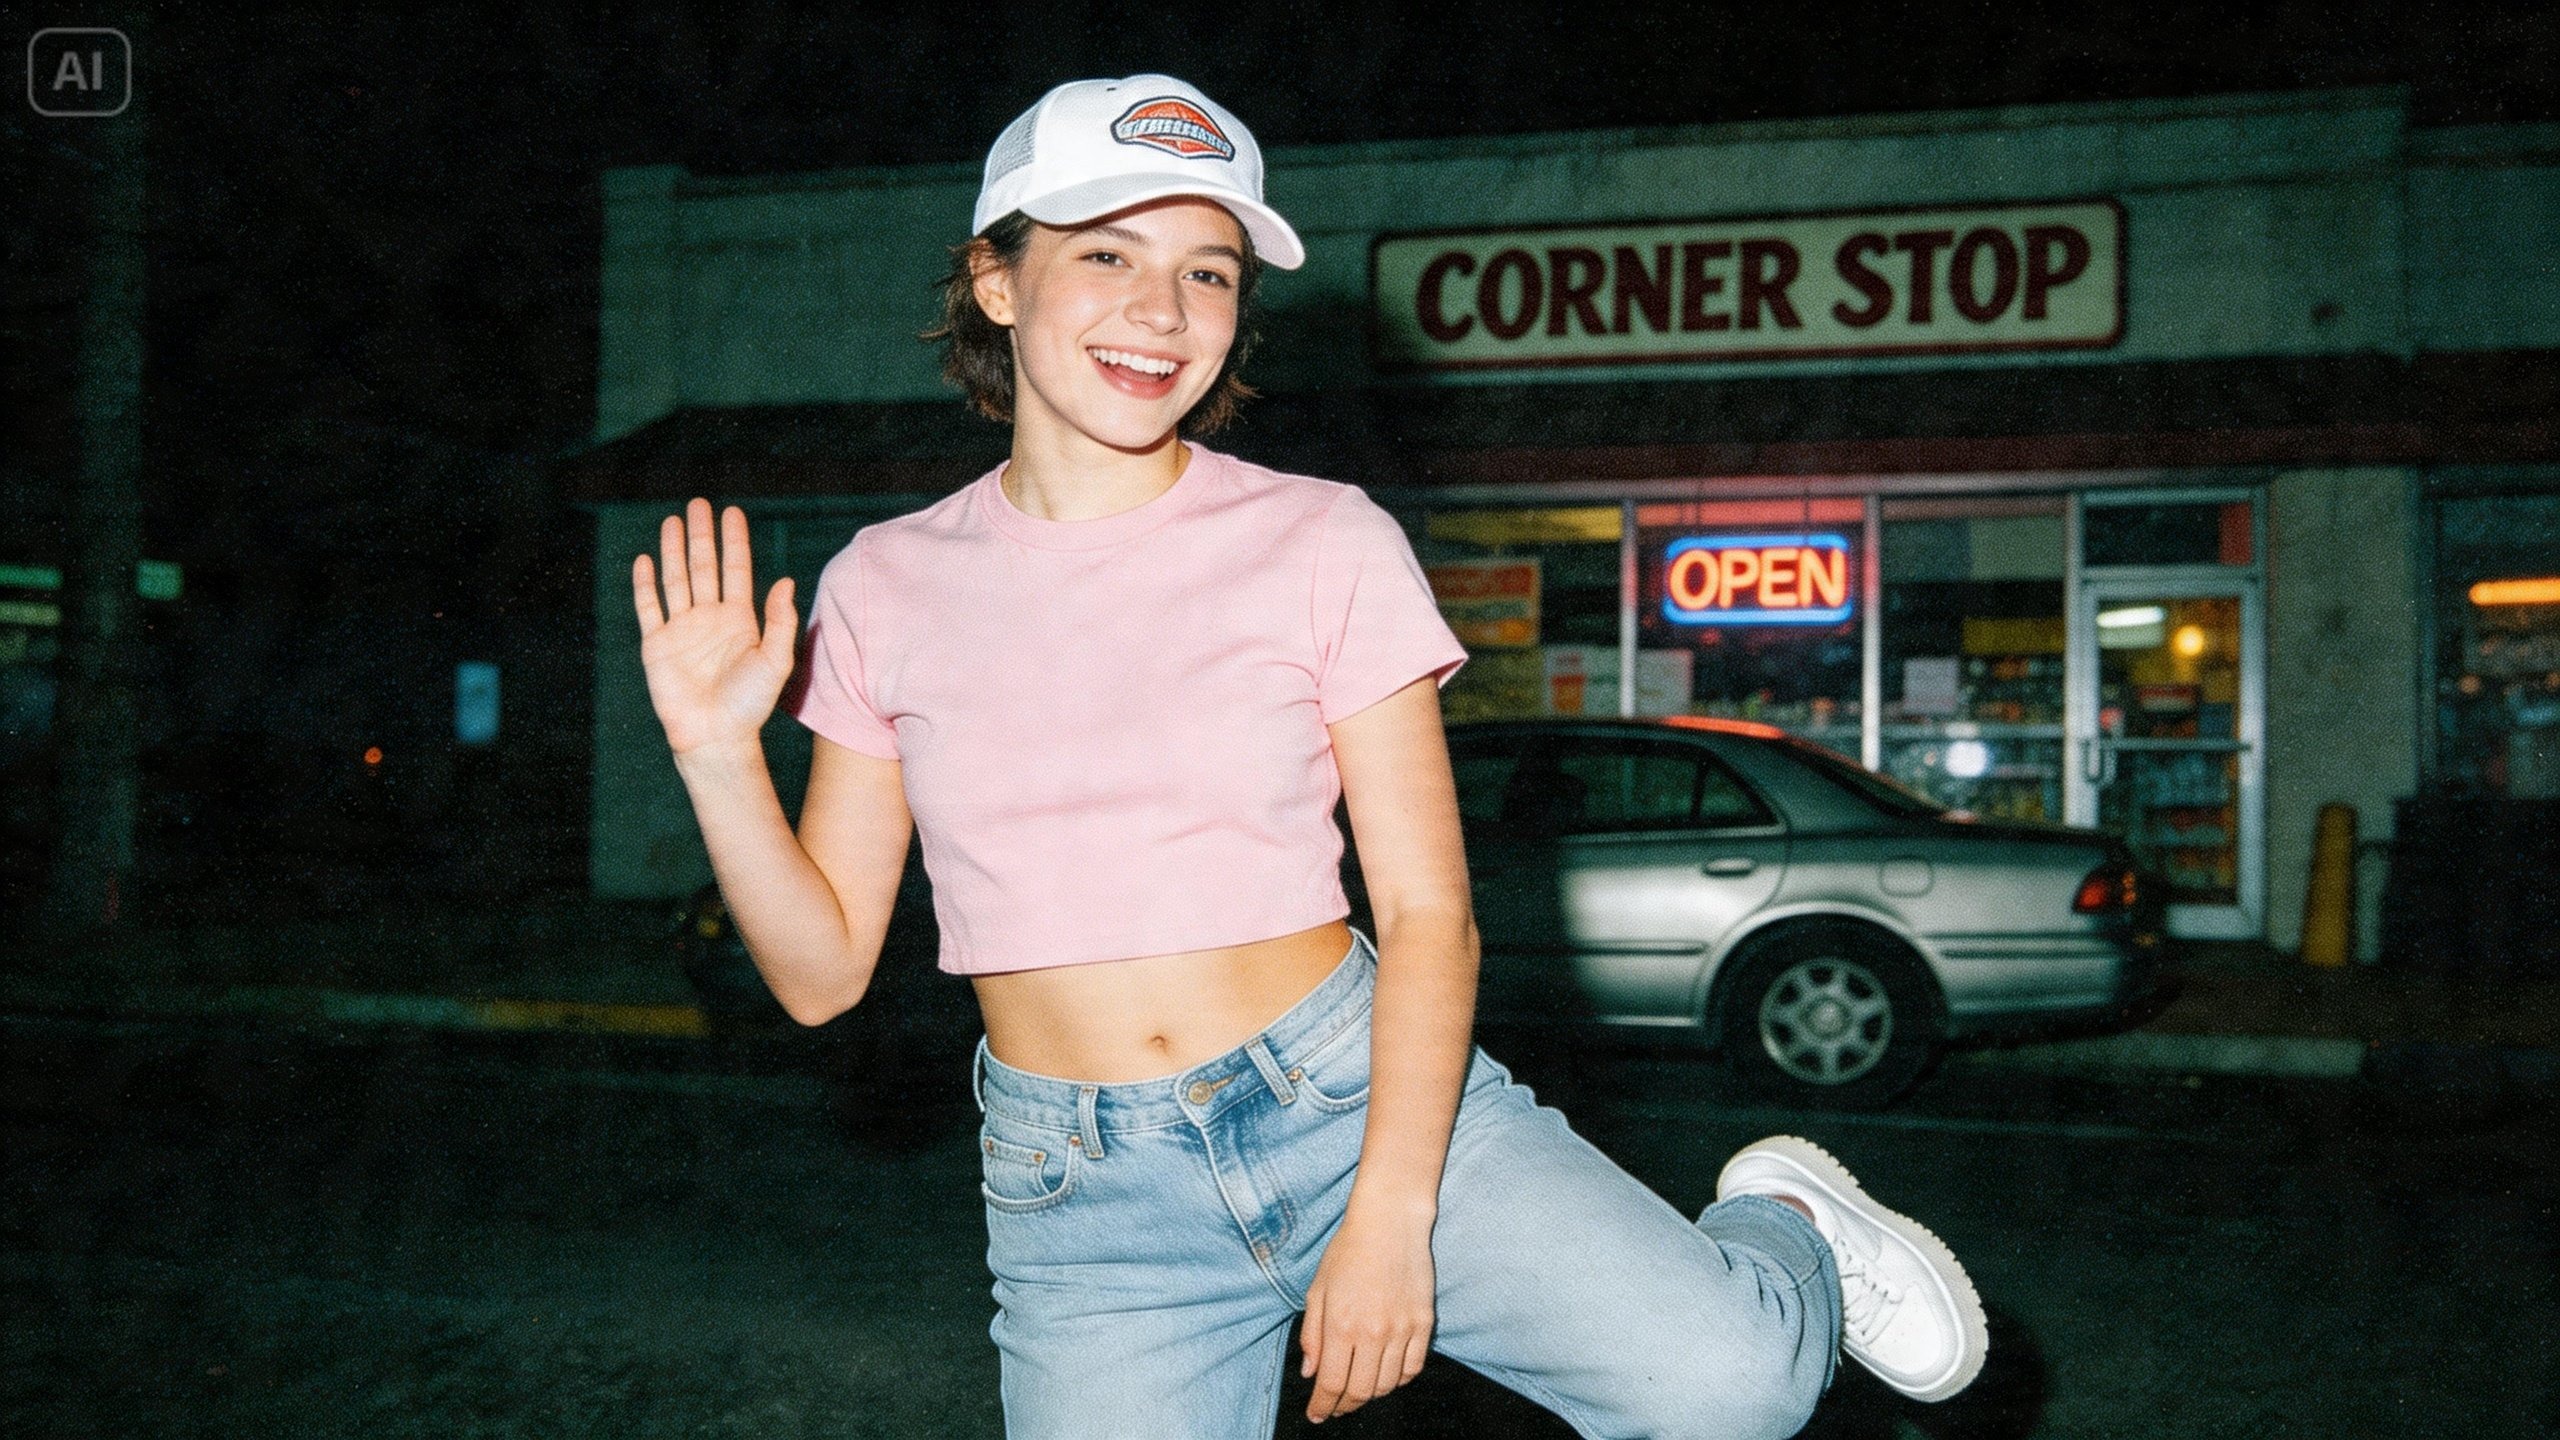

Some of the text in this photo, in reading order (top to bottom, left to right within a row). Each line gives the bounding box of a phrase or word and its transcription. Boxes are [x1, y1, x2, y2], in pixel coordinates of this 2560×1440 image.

[1415, 224, 2092, 343] CORNER STOP
[1668, 547, 1848, 610] OPEN
